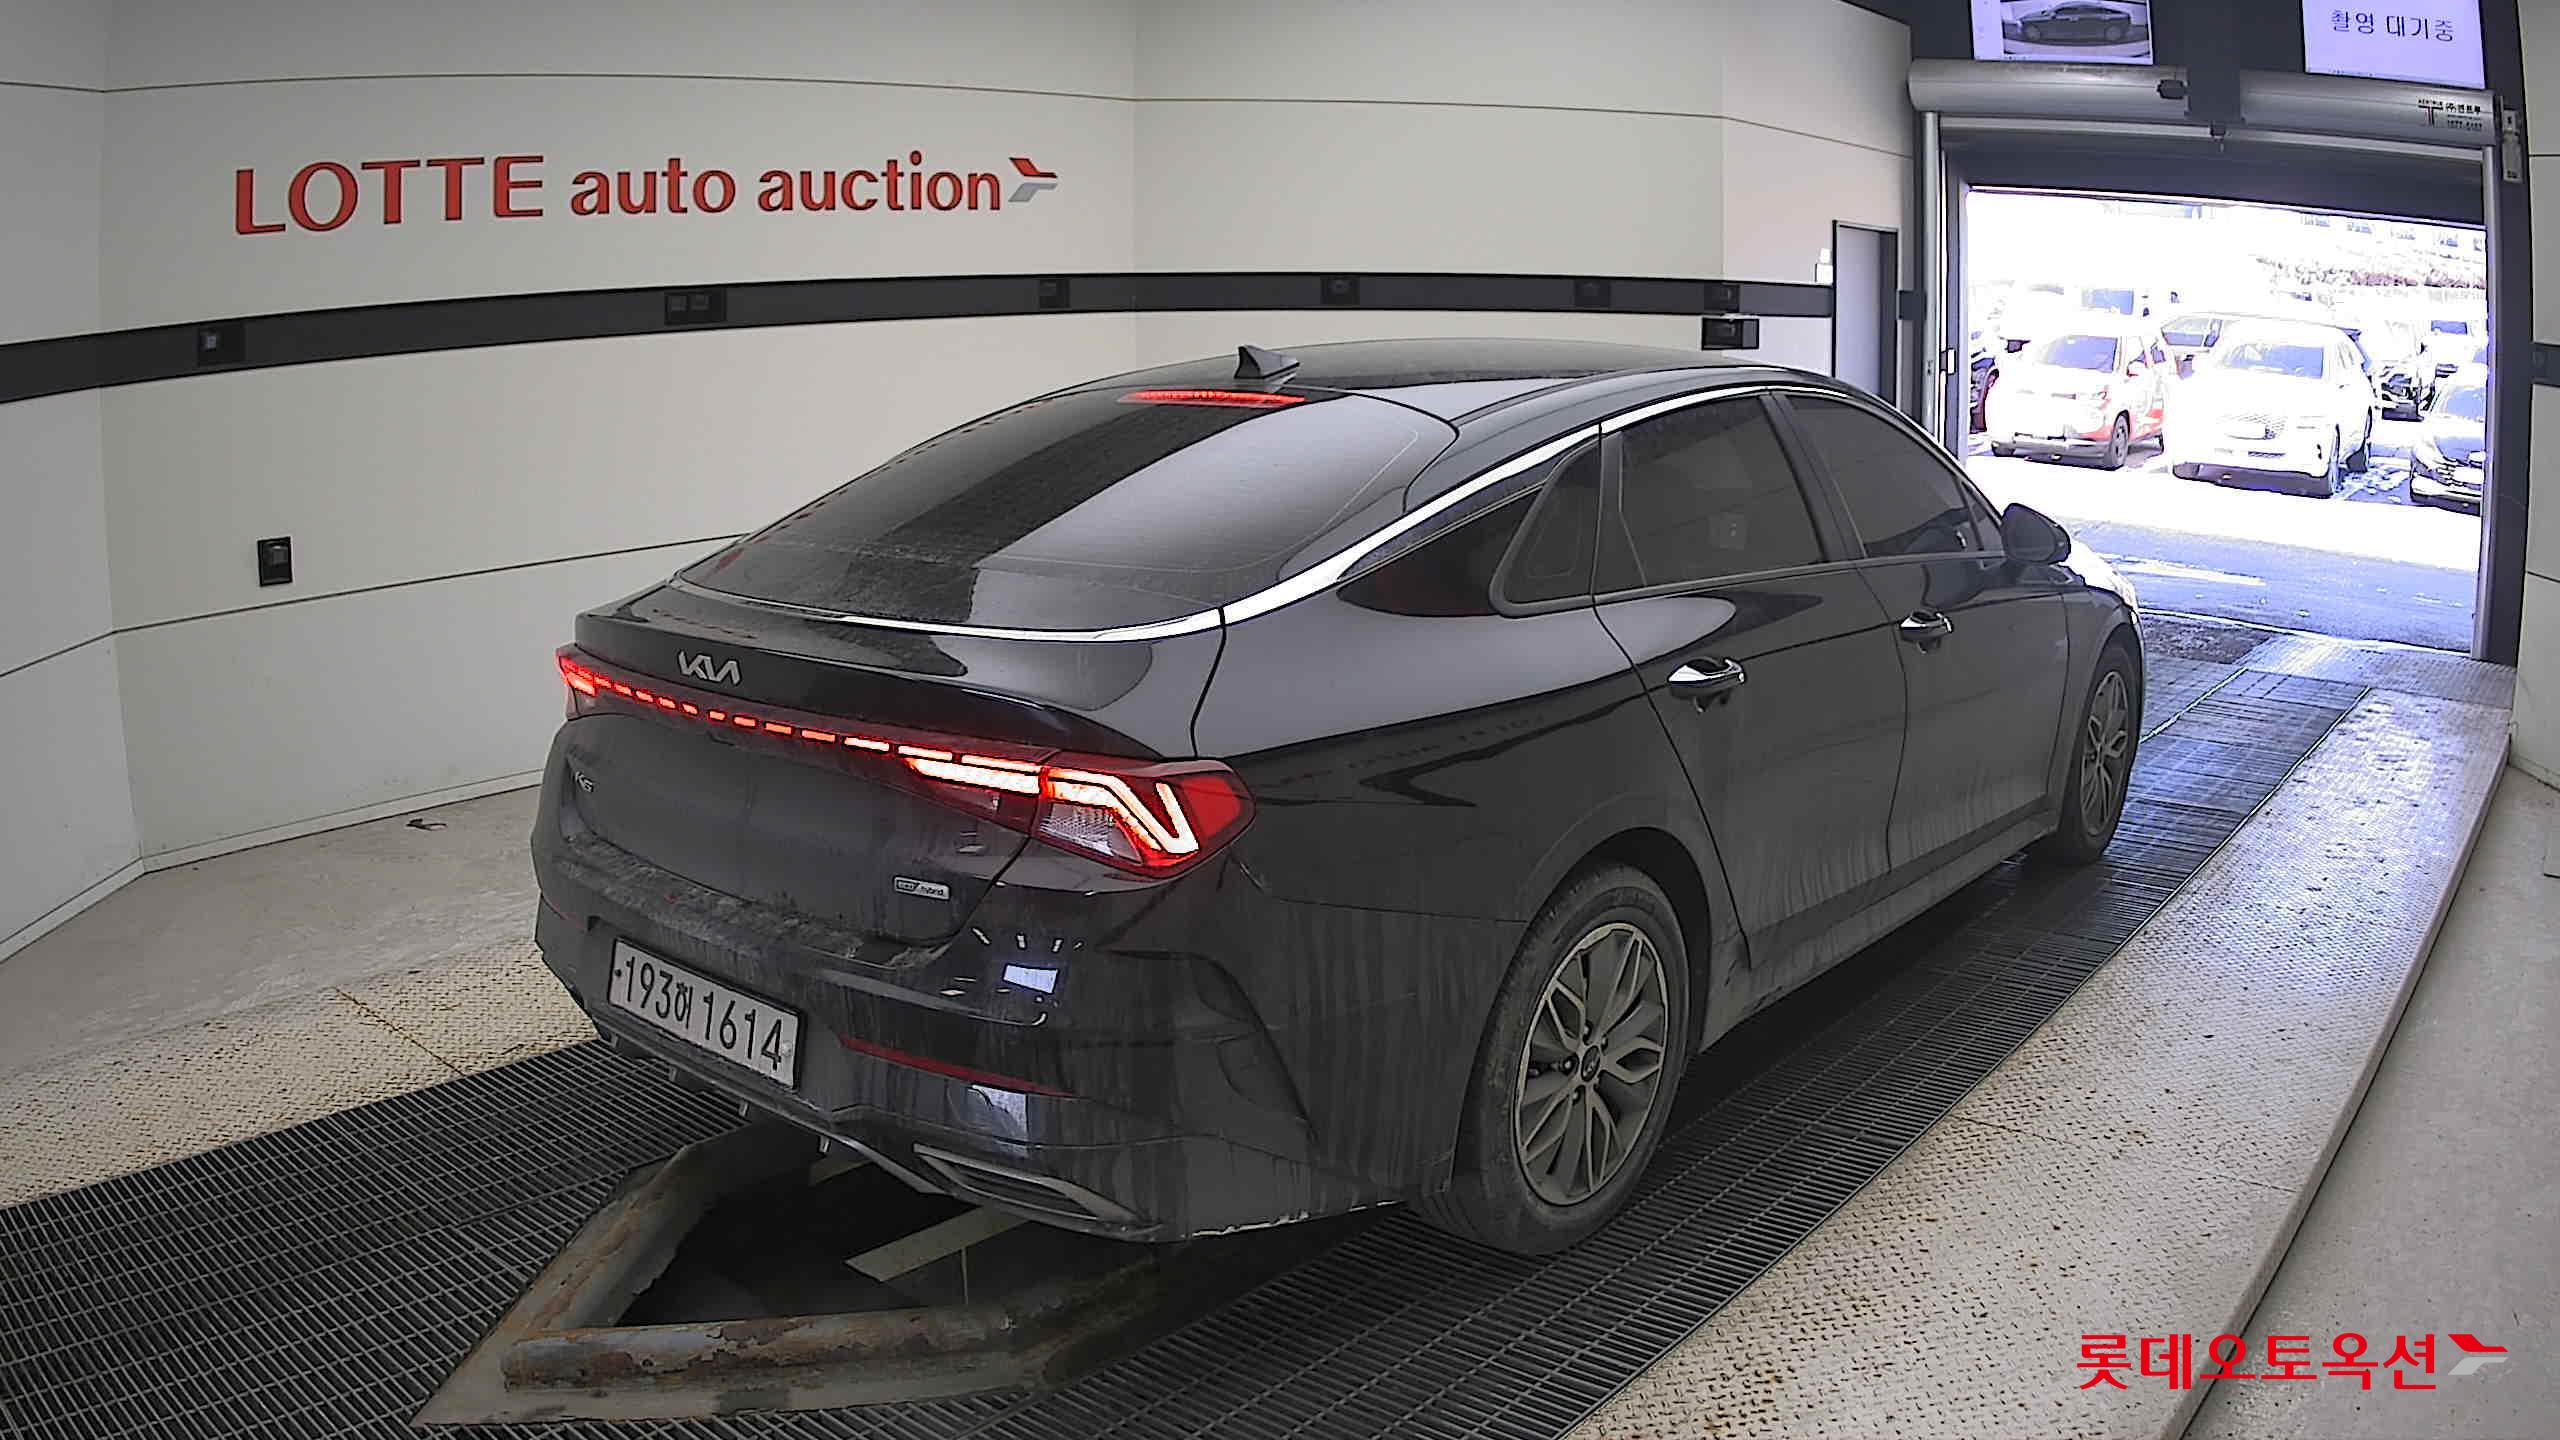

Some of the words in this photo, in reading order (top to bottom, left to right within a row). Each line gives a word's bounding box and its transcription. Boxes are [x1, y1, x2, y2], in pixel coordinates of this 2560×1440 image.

[2331, 10, 2375, 34] 촬영
[2386, 15, 2453, 42] 대기중
[236, 154, 544, 234] LOTTE
[570, 159, 735, 215] auto
[757, 150, 1001, 212] auction
[678, 651, 740, 685] KIA
[703, 991, 782, 1071] 1614
